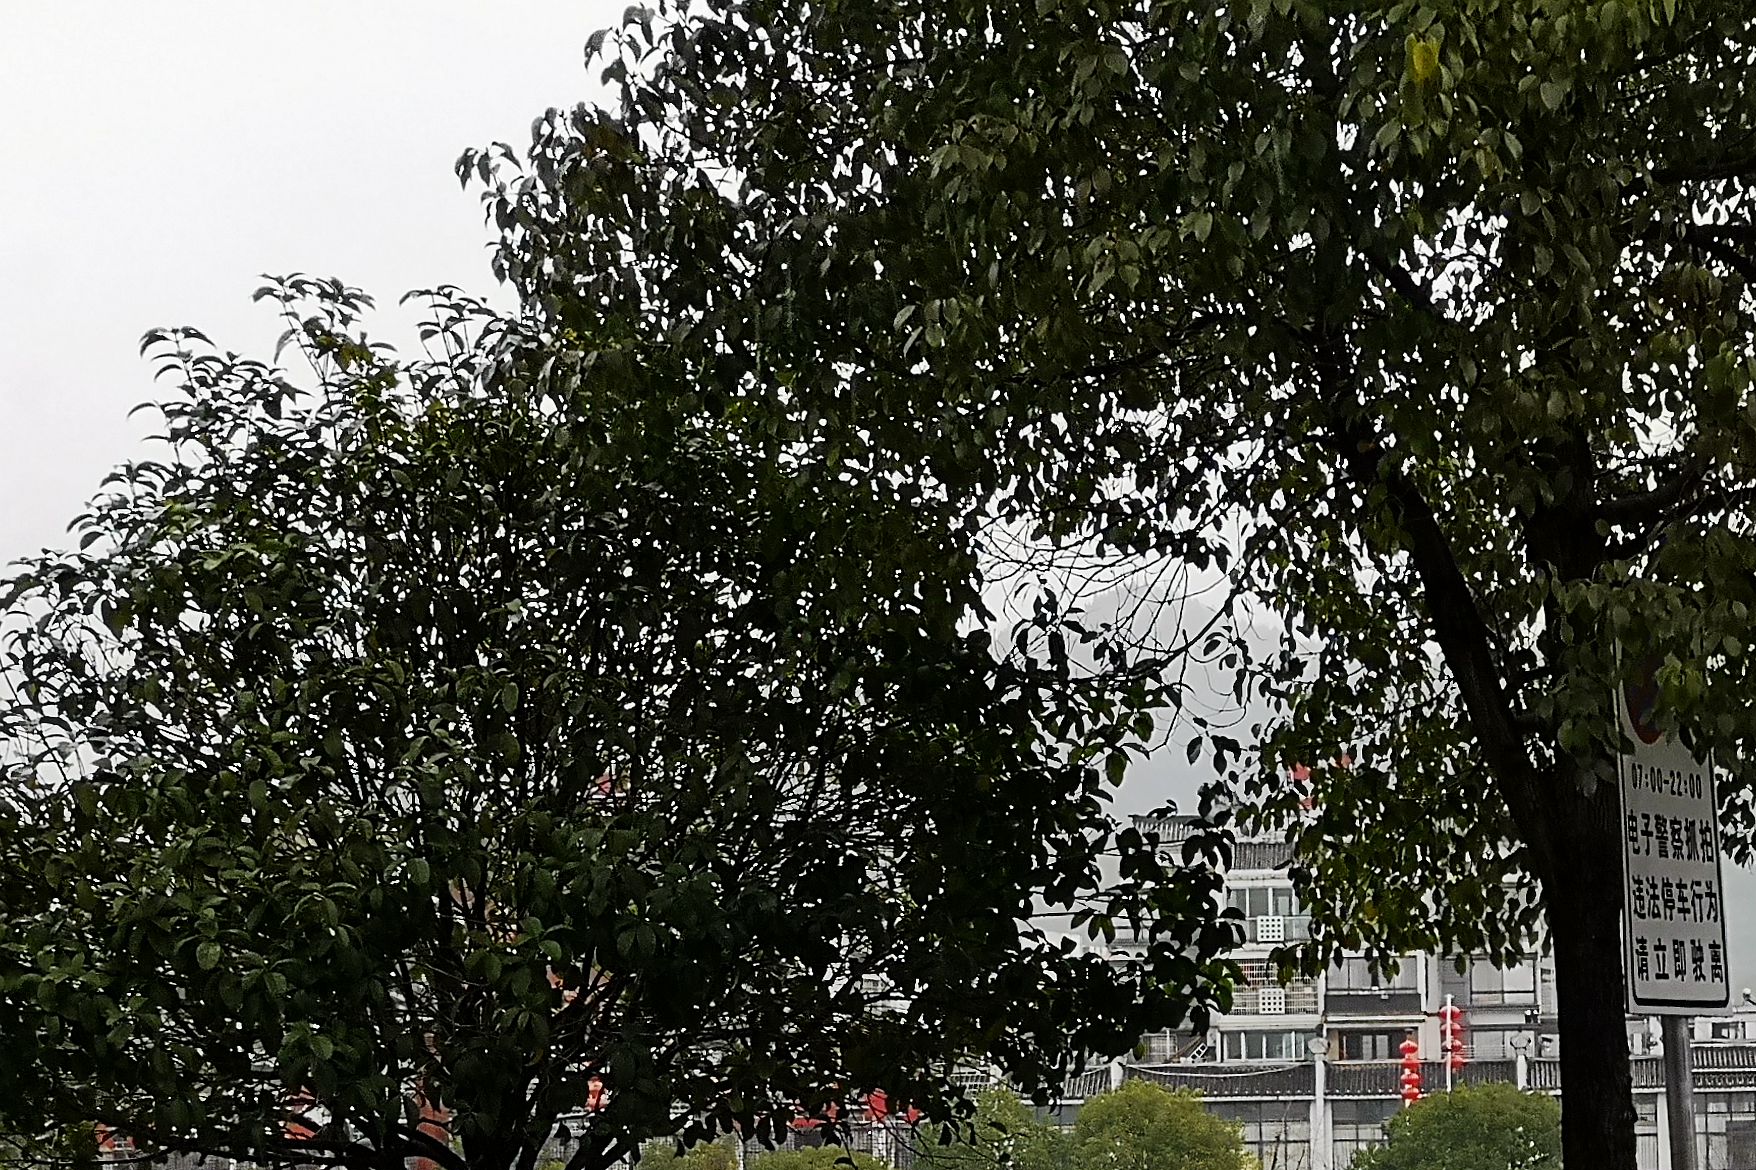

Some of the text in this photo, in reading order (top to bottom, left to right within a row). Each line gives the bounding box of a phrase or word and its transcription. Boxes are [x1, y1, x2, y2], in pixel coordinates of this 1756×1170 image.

[1631, 762, 1703, 800] 07:00-22:00
[1628, 809, 1714, 863] 电子警察抓拍
[1632, 875, 1719, 923] 违法停车行为
[1635, 936, 1724, 983] 请立即驶离
